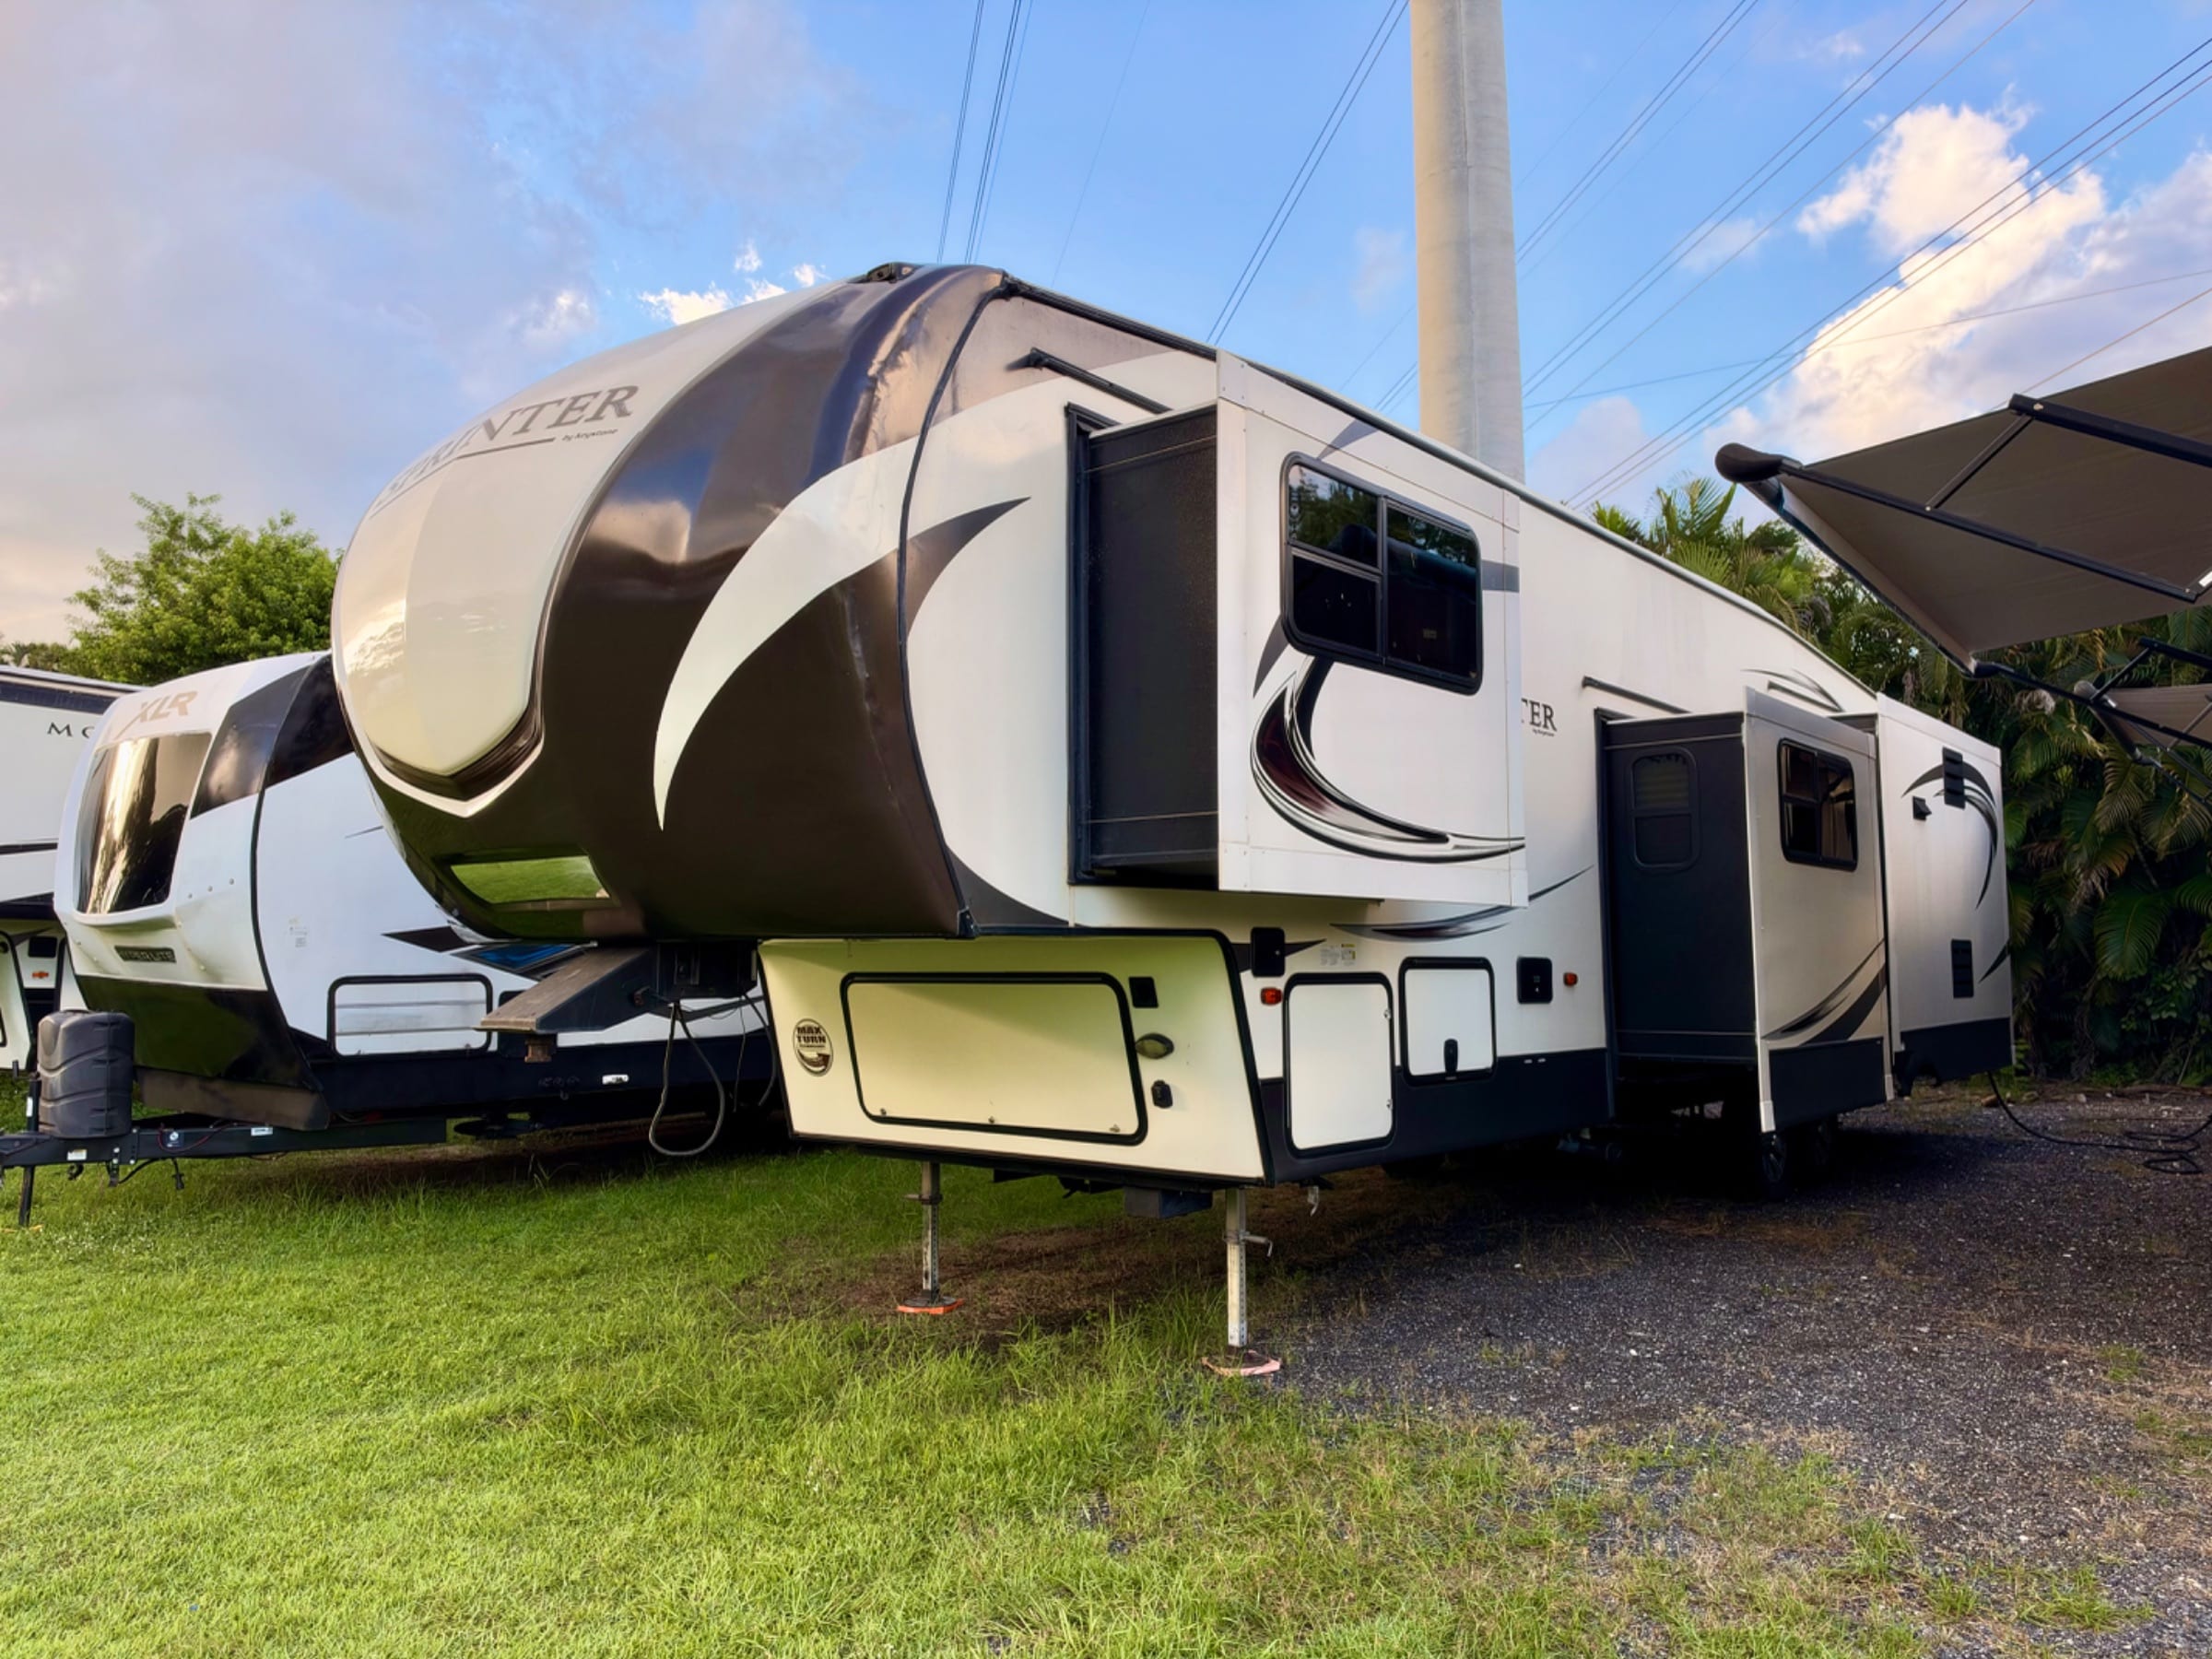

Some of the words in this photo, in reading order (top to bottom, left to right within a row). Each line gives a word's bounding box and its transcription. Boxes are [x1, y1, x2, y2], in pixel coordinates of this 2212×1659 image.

[376, 385, 639, 507] RINTER
[796, 1024, 822, 1034] MAX
[796, 1035, 827, 1043] TURN
